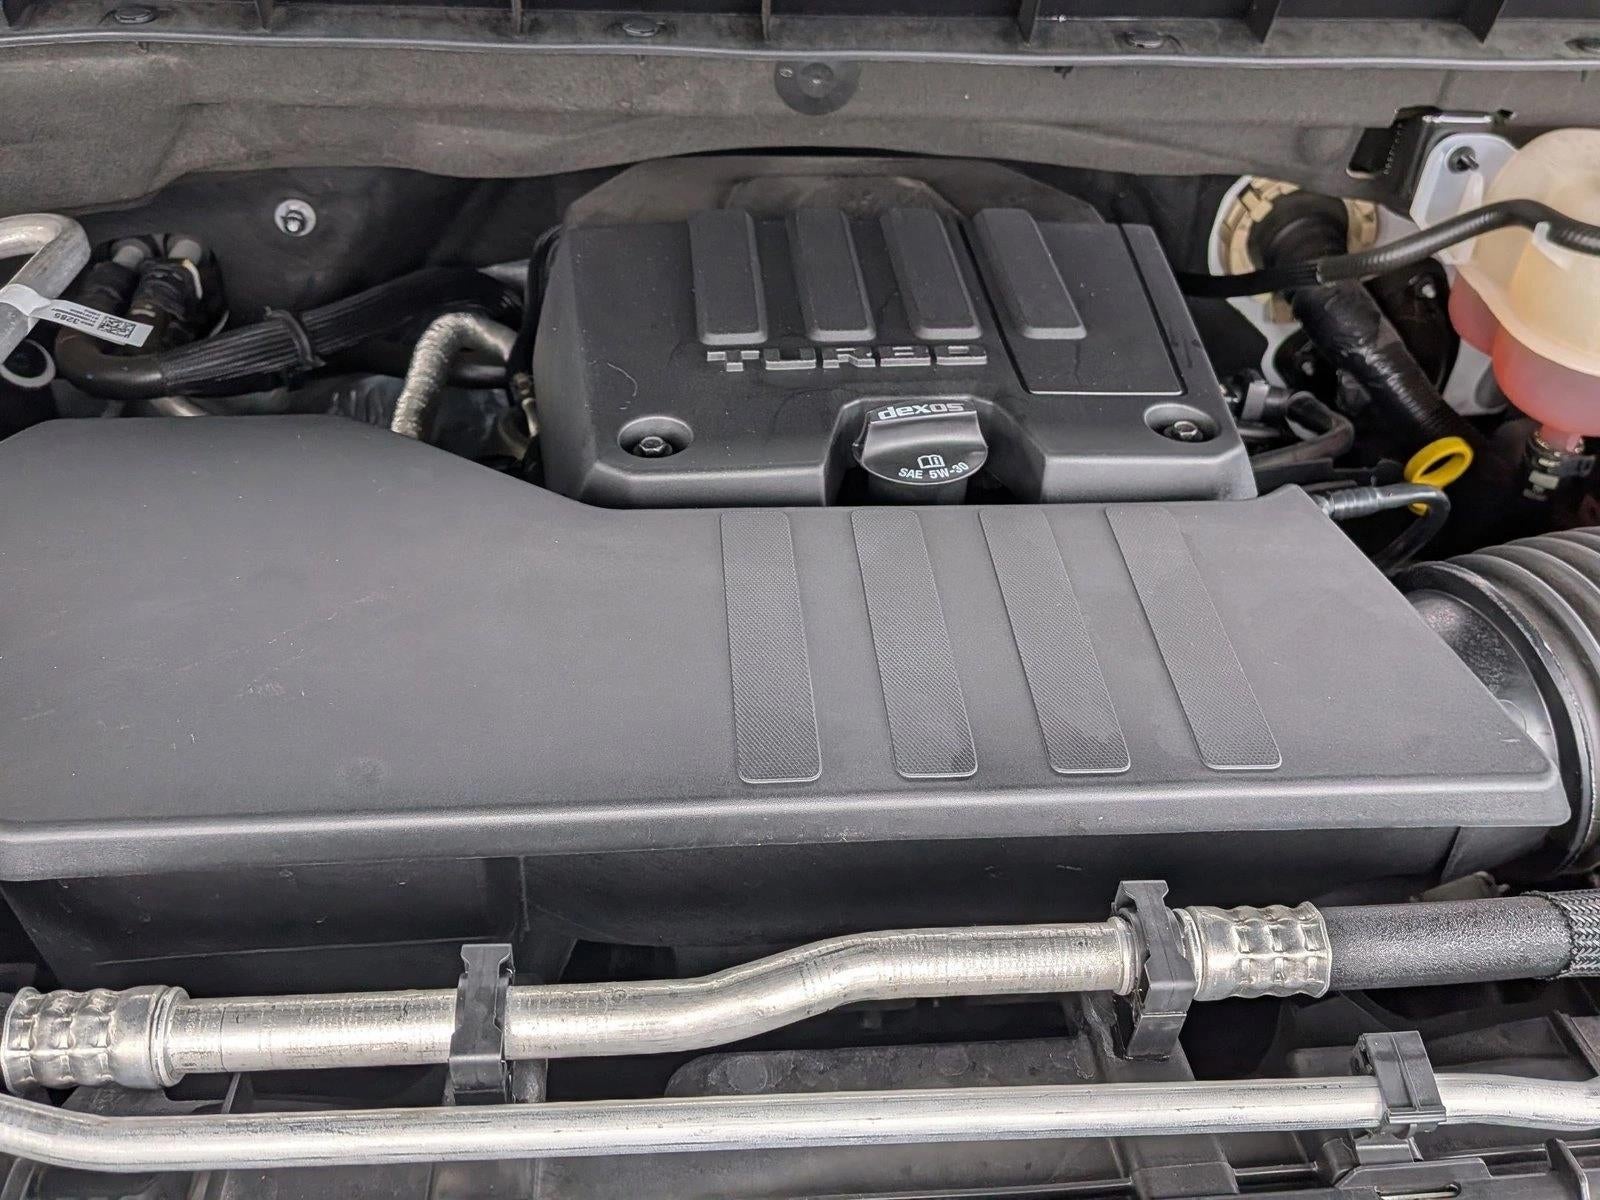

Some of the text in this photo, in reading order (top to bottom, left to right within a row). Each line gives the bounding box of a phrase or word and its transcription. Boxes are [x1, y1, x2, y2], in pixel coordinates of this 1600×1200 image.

[53, 312, 80, 325] 3285
[706, 345, 988, 372] TURBO
[878, 403, 964, 420] dexos
[898, 461, 970, 479] SAE 5W-30
